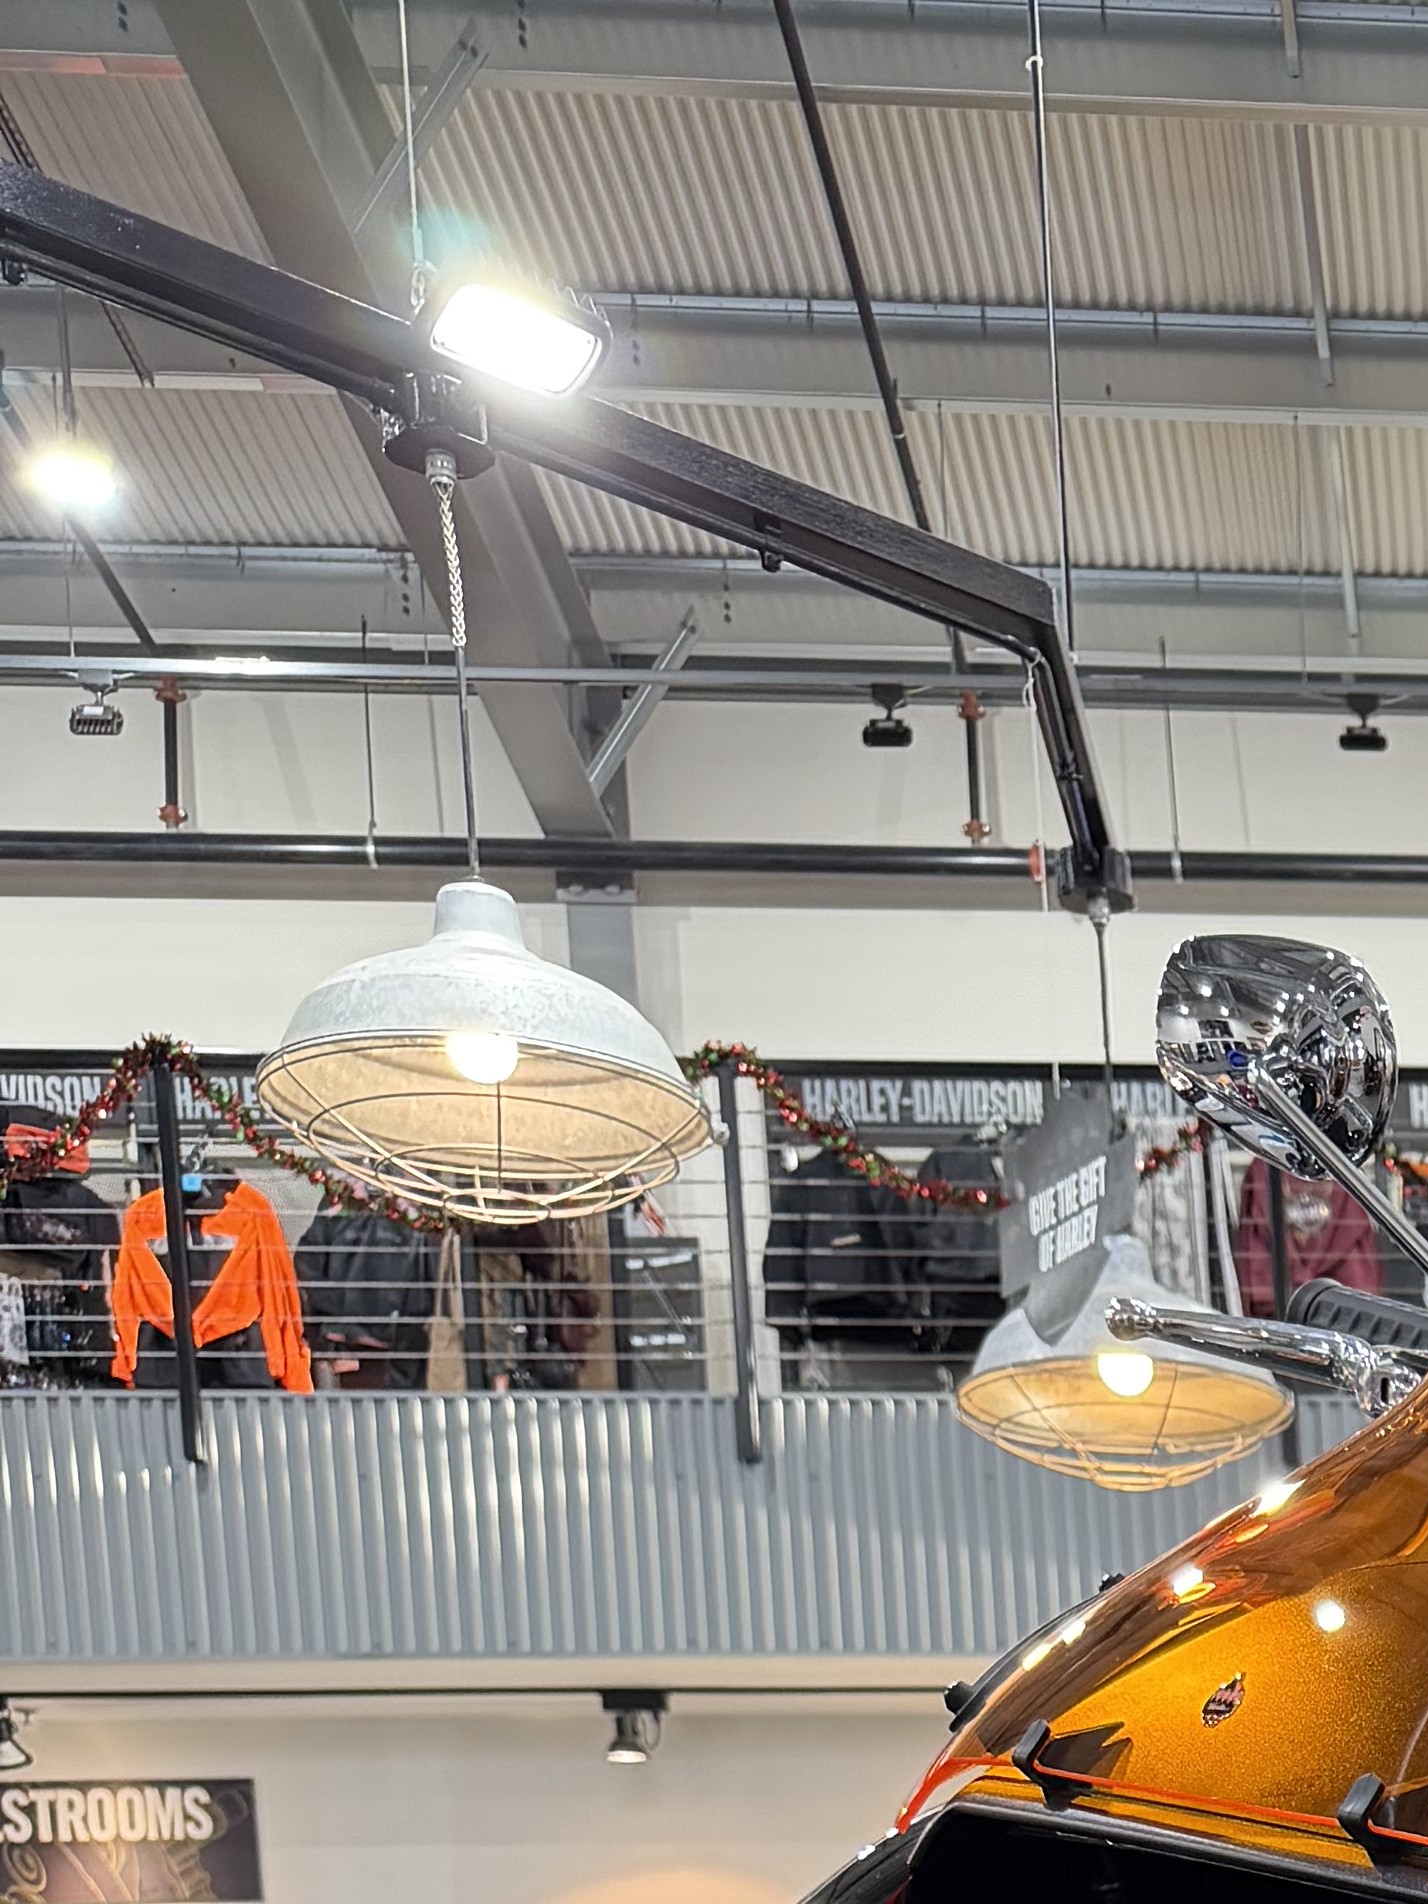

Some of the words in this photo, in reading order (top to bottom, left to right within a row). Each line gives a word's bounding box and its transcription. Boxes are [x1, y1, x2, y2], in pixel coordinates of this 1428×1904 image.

[802, 1078, 1044, 1125] HARLEY-DAVIDSON
[1028, 1186, 1058, 1236] GIVE
[1055, 1172, 1080, 1221] THE
[1079, 1155, 1107, 1208] GIFT
[1039, 1230, 1055, 1273] OF
[1055, 1203, 1099, 1265] HARLEY
[0, 1785, 214, 1845] STROOMS
